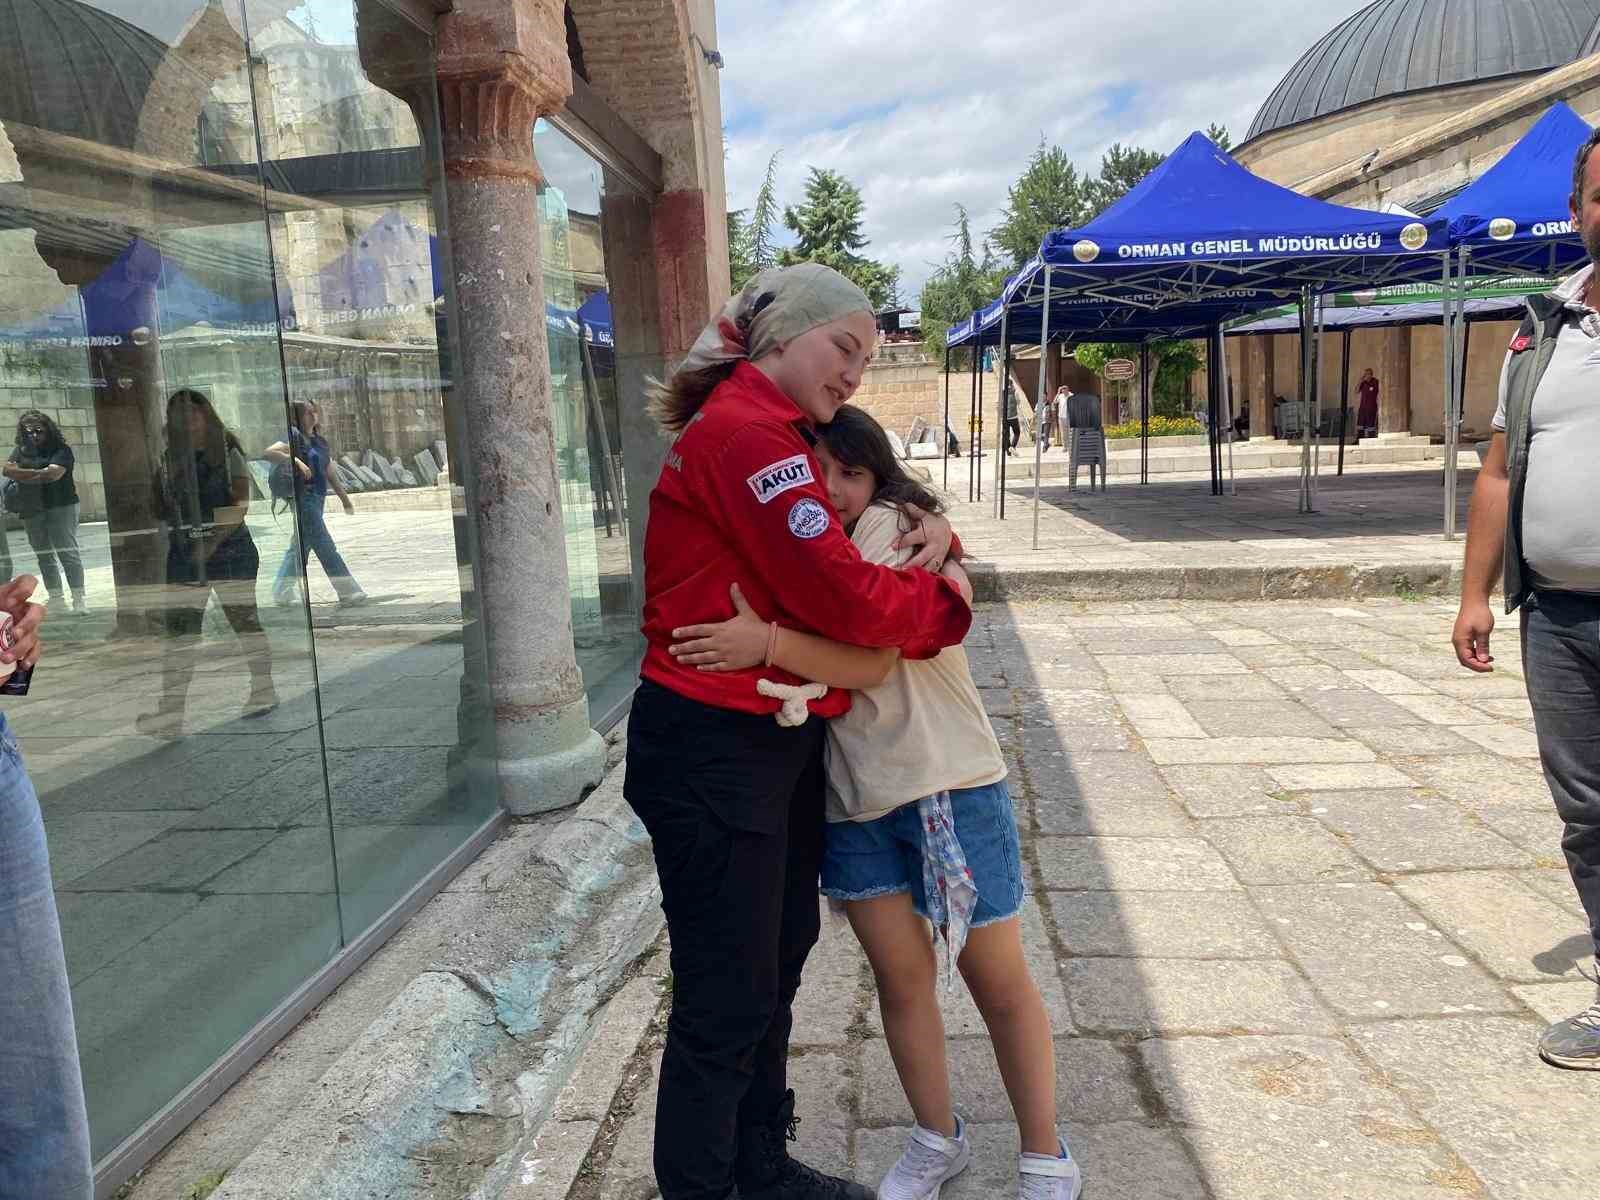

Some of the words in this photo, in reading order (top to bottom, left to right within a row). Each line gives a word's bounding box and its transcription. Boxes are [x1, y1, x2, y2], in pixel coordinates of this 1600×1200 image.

[1118, 243, 1185, 258] ORMAN
[1191, 240, 1253, 255] GENEL
[1259, 231, 1381, 252] MÜDÜRLÜĞÜ
[762, 463, 805, 493] AKUT
